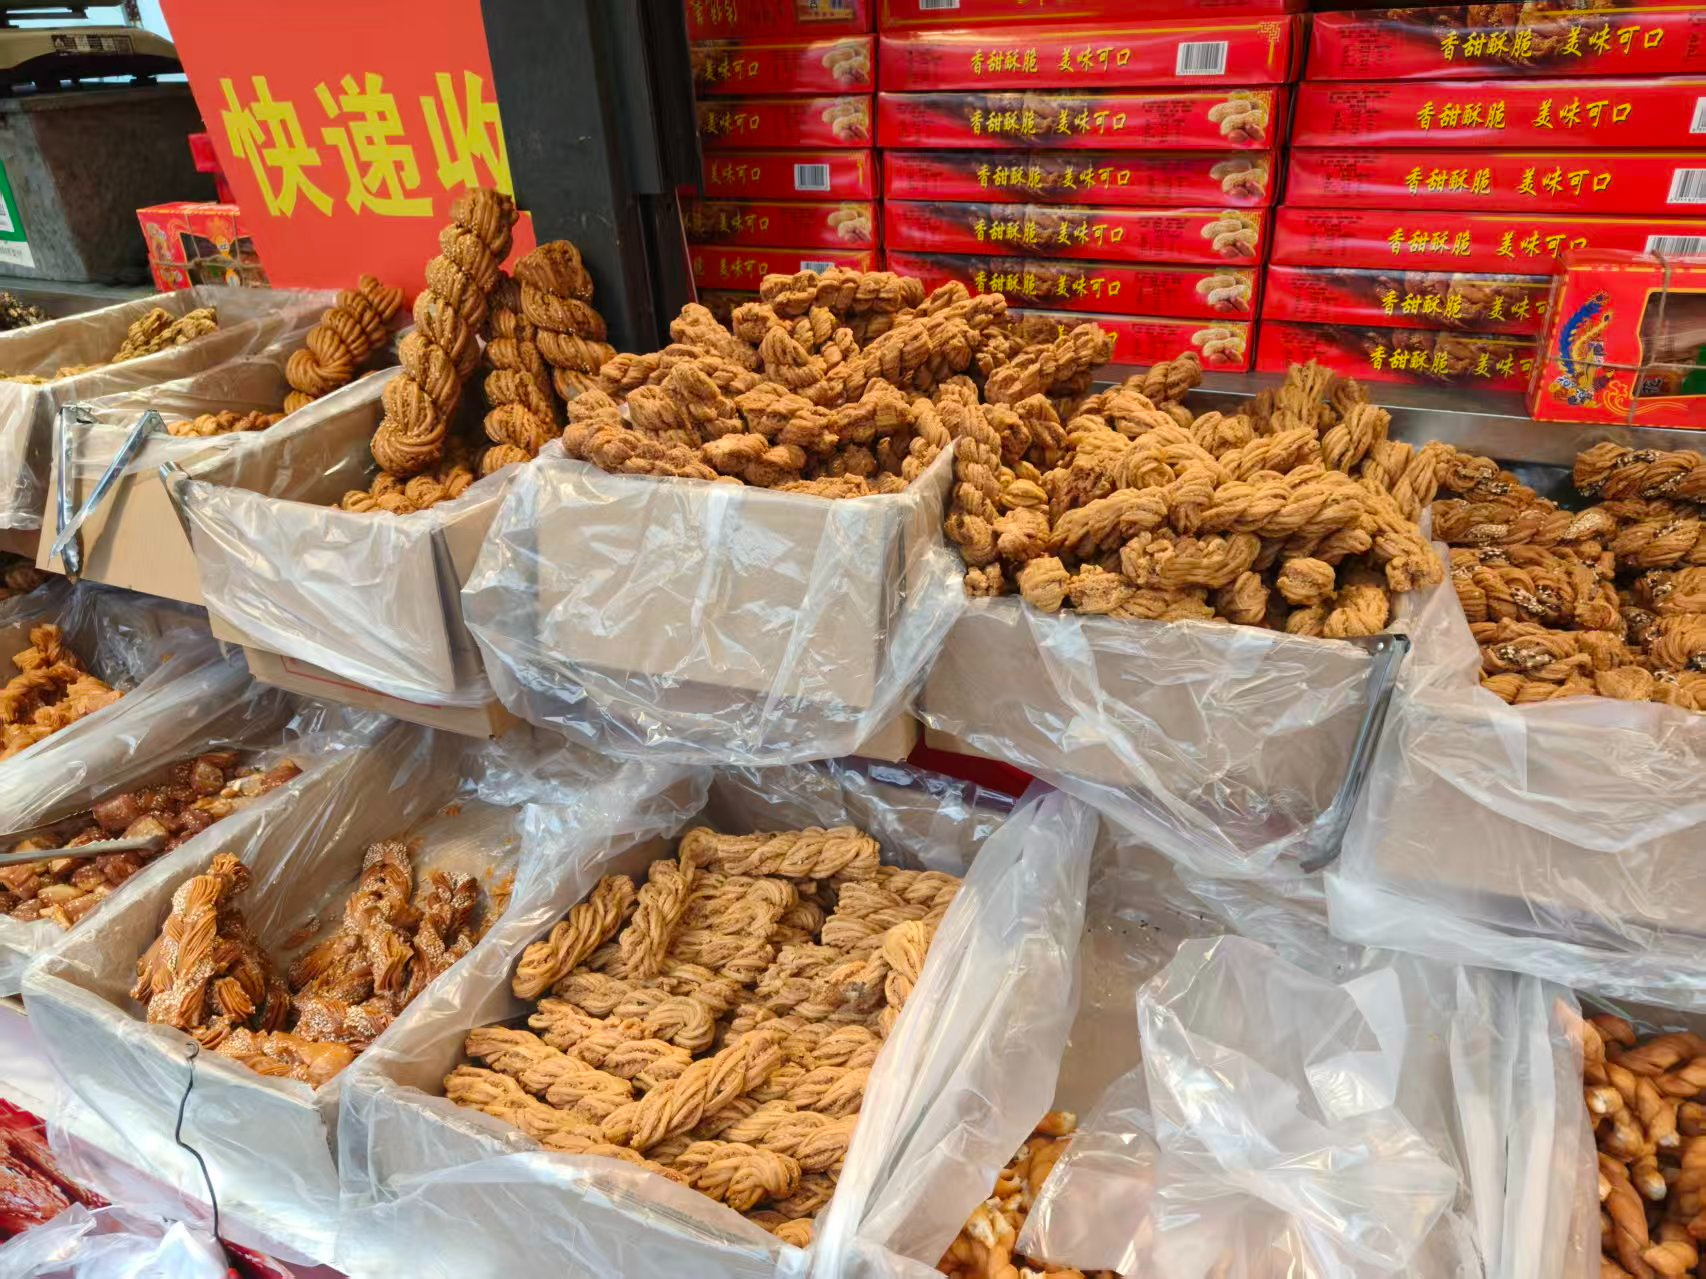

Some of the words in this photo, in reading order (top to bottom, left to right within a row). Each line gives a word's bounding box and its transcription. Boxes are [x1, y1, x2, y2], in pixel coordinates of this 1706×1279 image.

[1440, 28, 1533, 61] 香甜酥脆
[1561, 23, 1664, 56] 美味可口
[971, 49, 1038, 75] 香甜酥脆
[1057, 44, 1130, 73] 美味可口
[970, 109, 1036, 136] 香甜酥脆
[1056, 107, 1126, 136] 美味可口
[1417, 100, 1506, 131] 香甜酥脆
[1533, 96, 1632, 129] 美味可口
[977, 164, 1042, 189] 香甜酥脆
[1063, 163, 1130, 189] 美味可口
[1405, 166, 1492, 196] 香甜酥脆
[1517, 166, 1612, 197] 美味可口
[975, 218, 1037, 244] 香甜酥脆
[1057, 221, 1124, 246] 美味可口
[1387, 228, 1472, 256] 香甜酥脆
[975, 271, 1037, 295] 香甜酥脆
[1057, 274, 1121, 299] 美味可口
[1381, 290, 1463, 319] 香甜酥脆
[1369, 345, 1450, 375] 香甜酥脆
